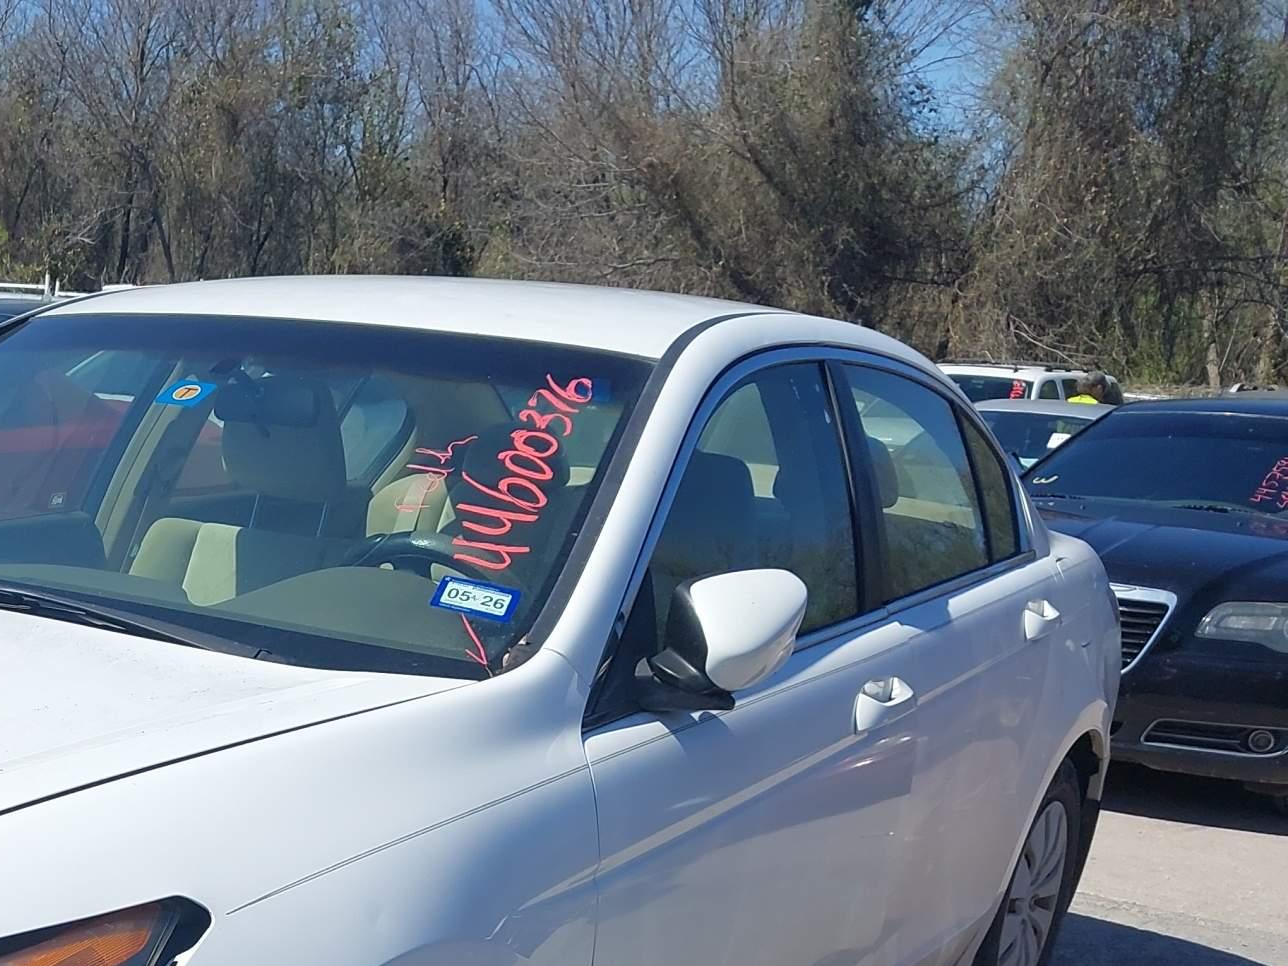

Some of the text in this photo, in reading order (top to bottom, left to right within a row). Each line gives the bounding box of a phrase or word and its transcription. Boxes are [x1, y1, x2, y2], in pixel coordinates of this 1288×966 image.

[451, 374, 593, 570] 44600376
[446, 587, 472, 603] 05
[480, 594, 506, 610] 26
